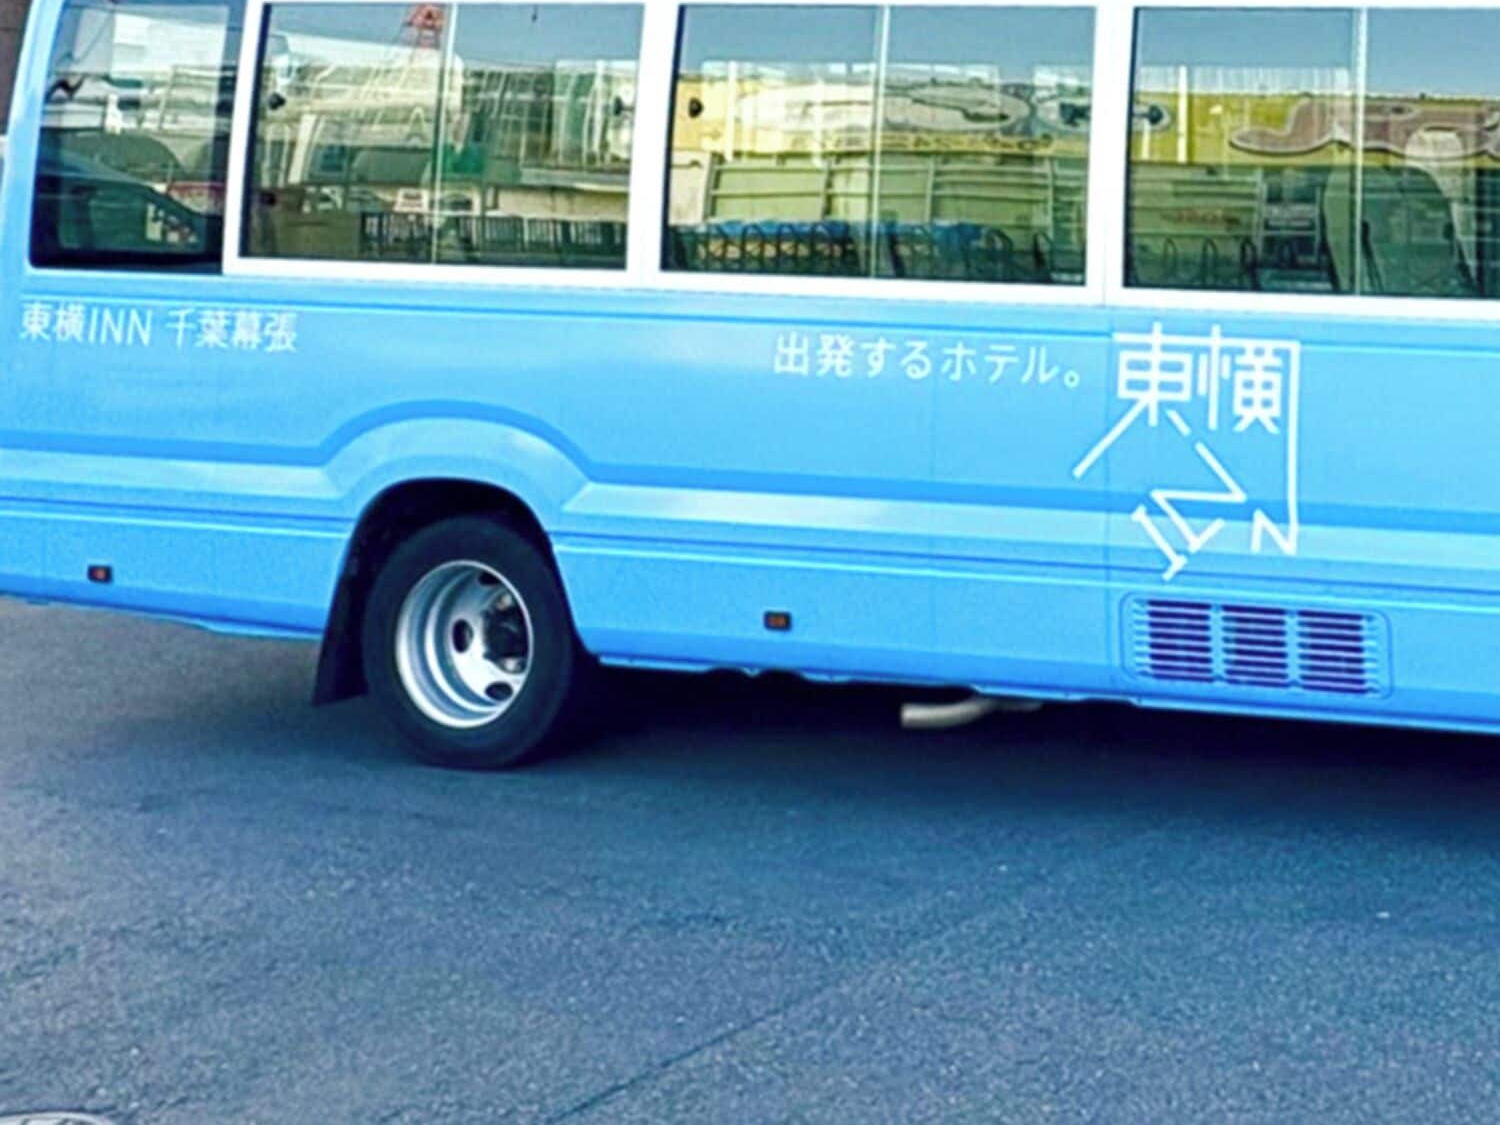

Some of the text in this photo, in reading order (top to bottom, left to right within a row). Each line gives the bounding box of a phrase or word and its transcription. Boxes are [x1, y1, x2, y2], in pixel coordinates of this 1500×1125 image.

[20, 301, 299, 353] 東横INN 千葉幕張
[773, 331, 1080, 389] 出発するホテル。
